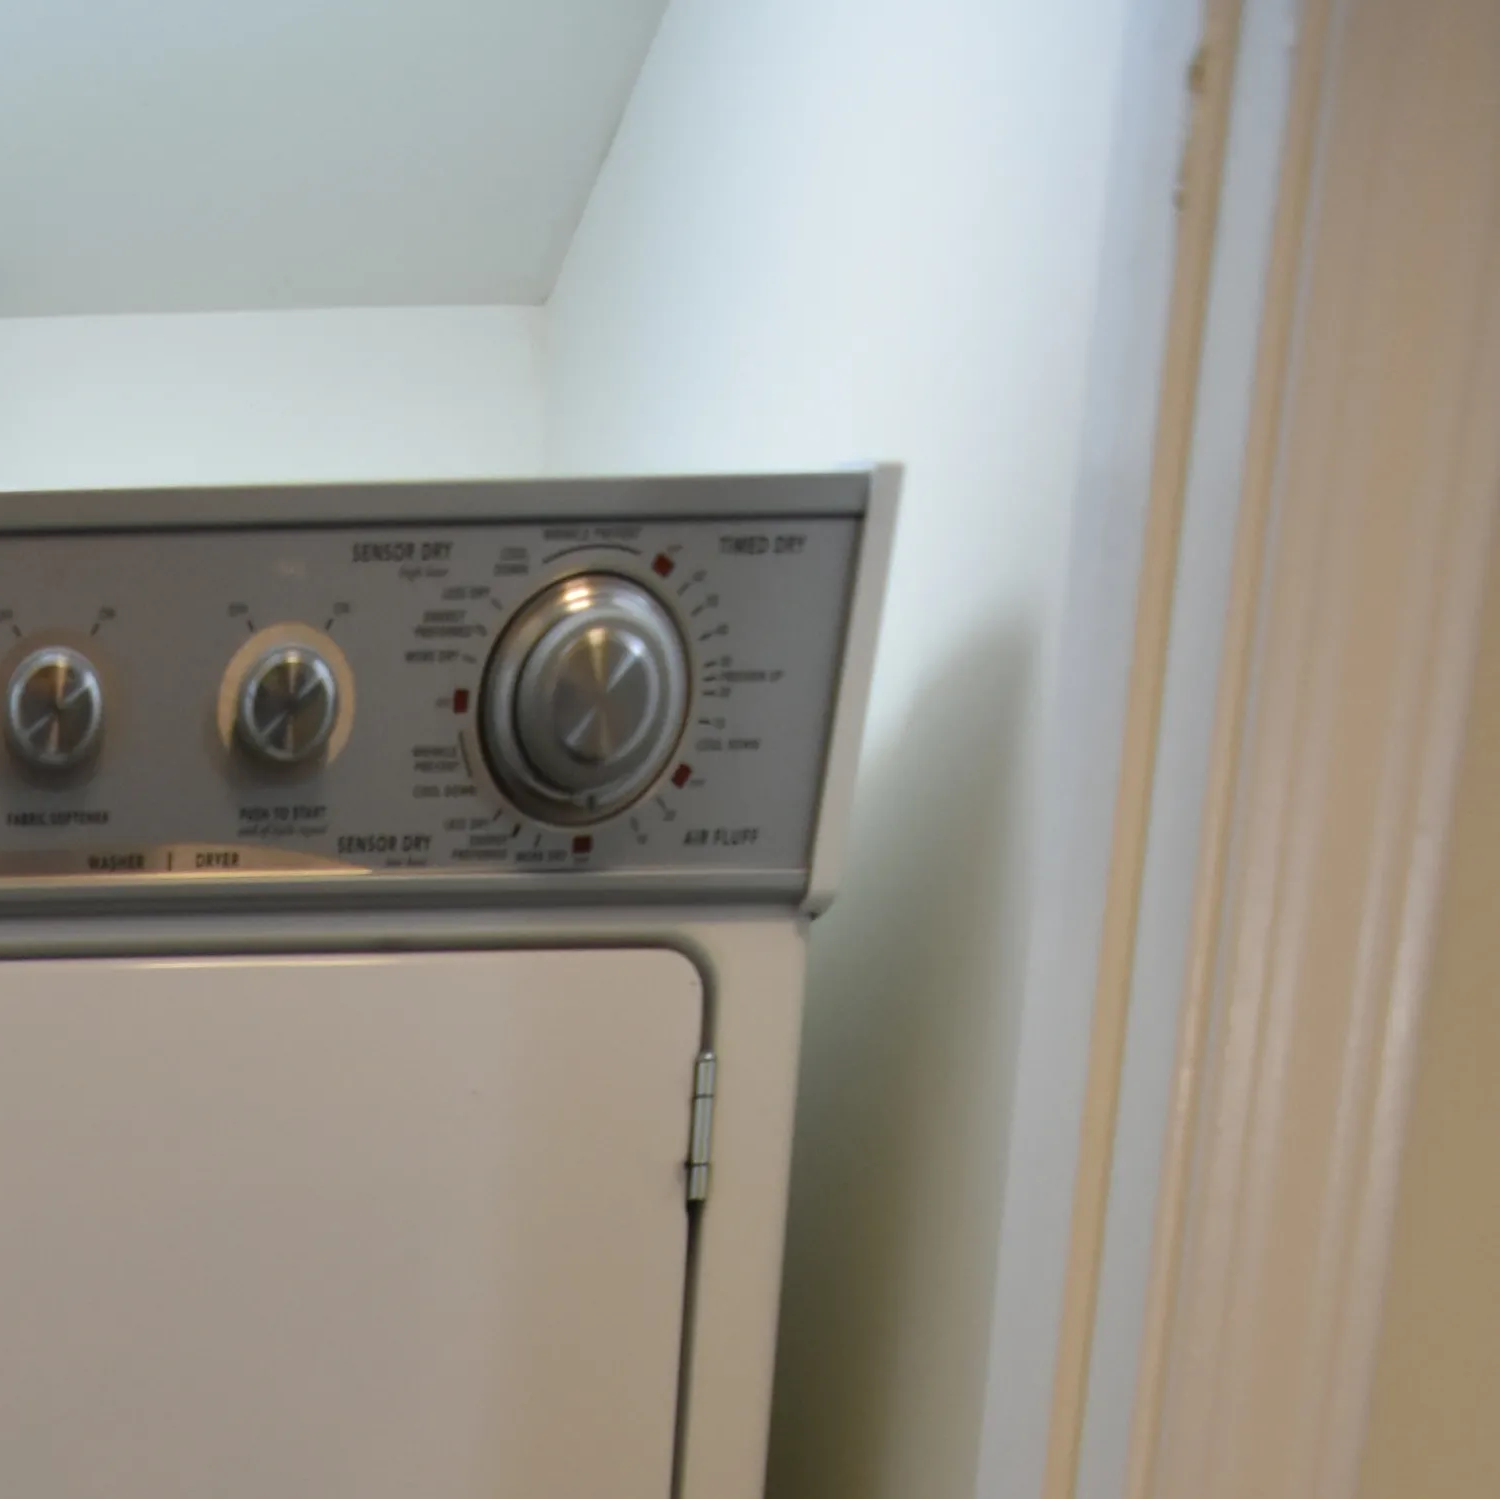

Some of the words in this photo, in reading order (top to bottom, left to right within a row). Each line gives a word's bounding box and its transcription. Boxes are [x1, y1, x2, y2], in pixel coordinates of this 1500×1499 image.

[352, 541, 415, 562] SENSOR
[420, 540, 454, 561] DRY
[719, 535, 770, 555] TIMED
[773, 534, 808, 554] DRY
[6, 810, 47, 827] FABRIC
[337, 834, 398, 855] SENSOR
[401, 833, 432, 852] DRY
[681, 828, 709, 846] AIR
[713, 826, 761, 846] FLUFF
[87, 851, 146, 871] WASHER
[195, 850, 241, 869] DRYER
